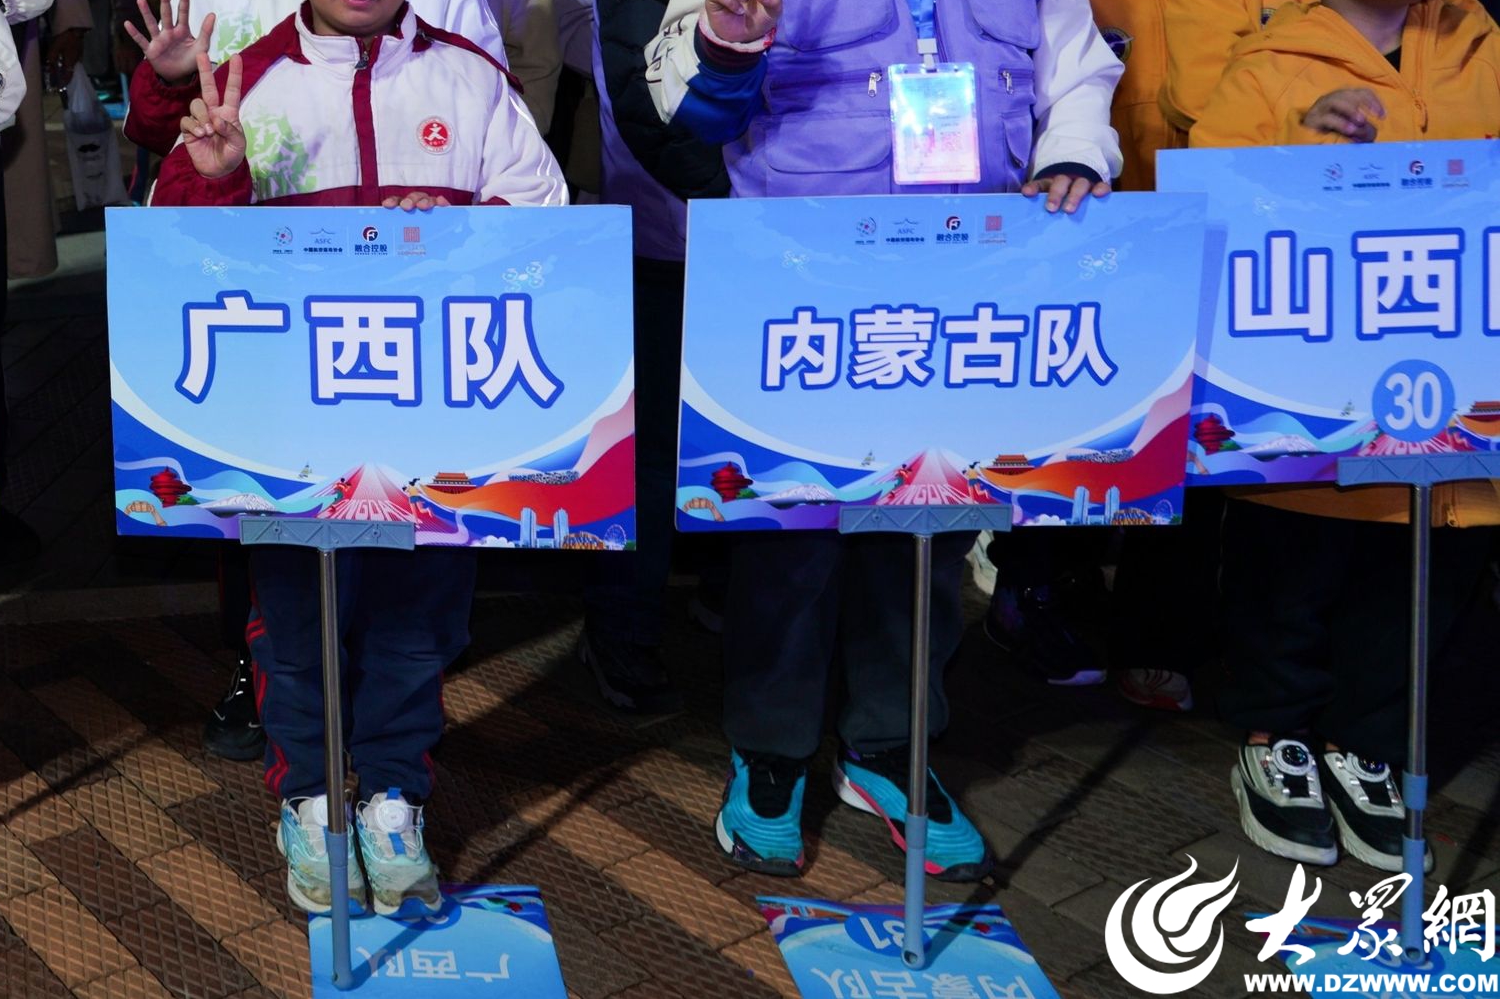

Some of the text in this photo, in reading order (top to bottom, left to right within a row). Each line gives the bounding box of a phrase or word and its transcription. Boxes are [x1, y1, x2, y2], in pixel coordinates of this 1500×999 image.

[354, 244, 388, 252] 融合控股
[1229, 226, 1500, 343] 山西
[176, 290, 565, 409] 广西队
[761, 303, 1118, 390] 内蒙古队
[1384, 371, 1442, 430] 30
[356, 946, 510, 984] 广西队
